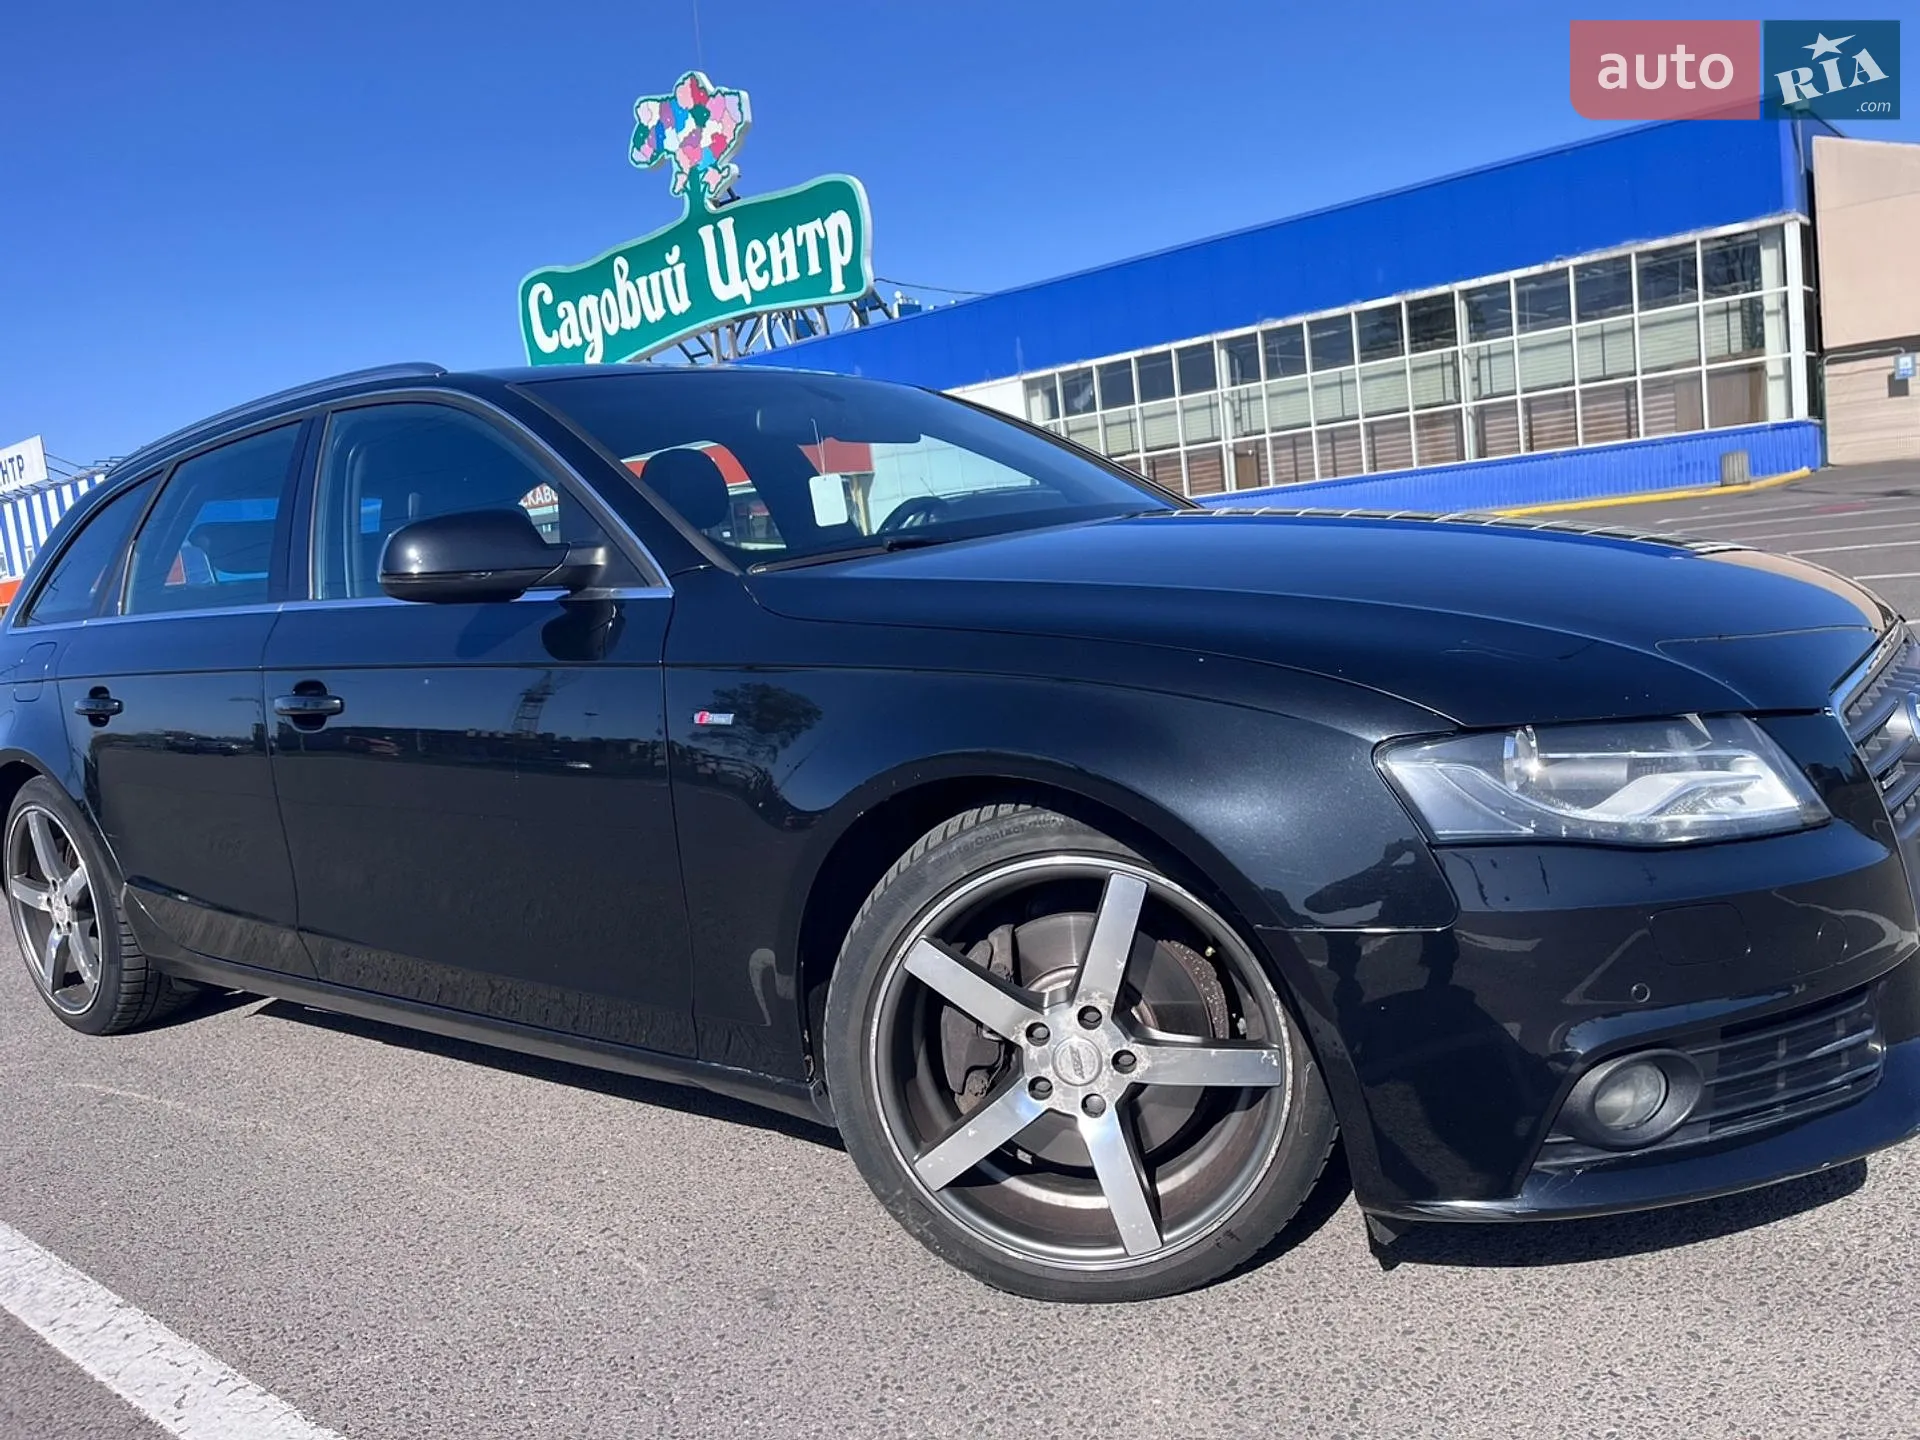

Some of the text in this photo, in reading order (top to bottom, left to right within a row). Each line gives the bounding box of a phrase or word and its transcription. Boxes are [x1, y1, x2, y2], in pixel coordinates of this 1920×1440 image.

[528, 209, 853, 364] Садовий Центр
[0, 454, 25, 486] НТР
